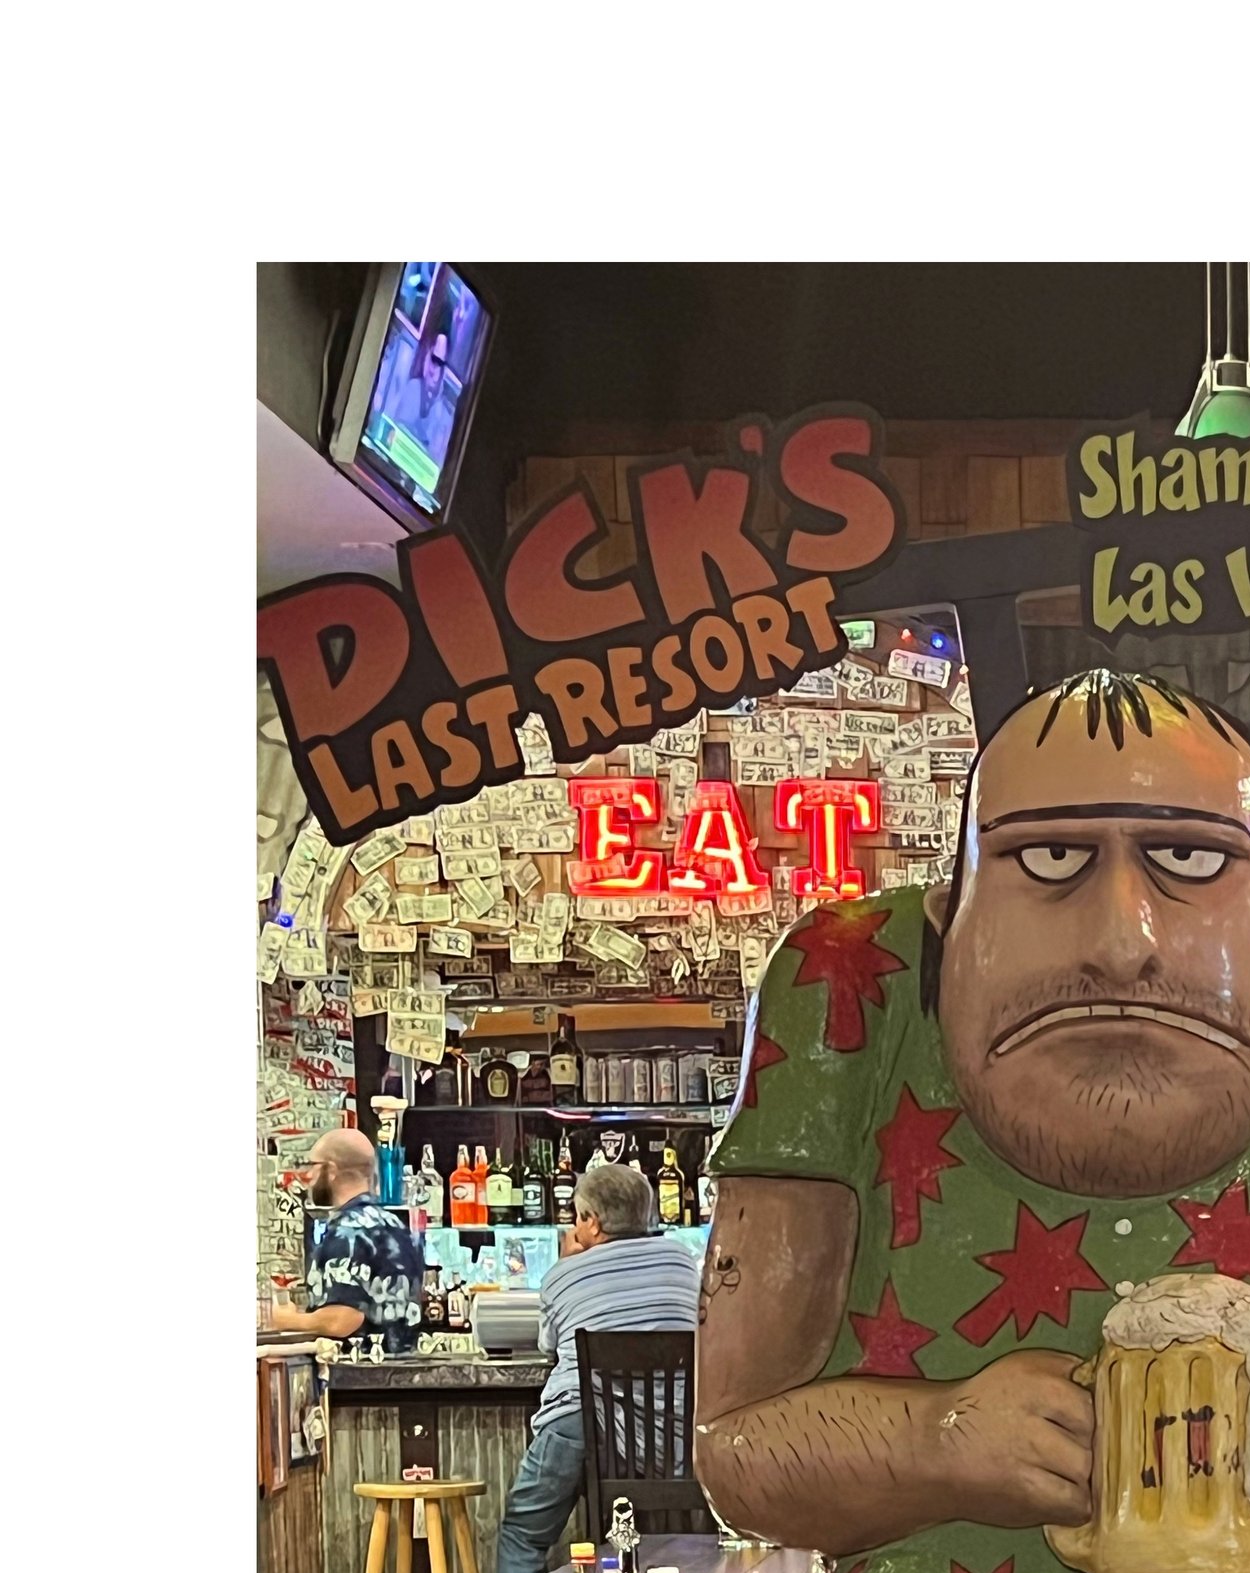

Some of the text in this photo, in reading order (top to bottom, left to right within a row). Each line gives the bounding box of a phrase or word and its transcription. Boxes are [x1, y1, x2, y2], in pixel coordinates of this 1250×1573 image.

[256, 417, 895, 742] DICK'S
[1092, 546, 1205, 633] Las
[308, 576, 837, 829] LAST RESORT
[568, 777, 881, 897] EAT
